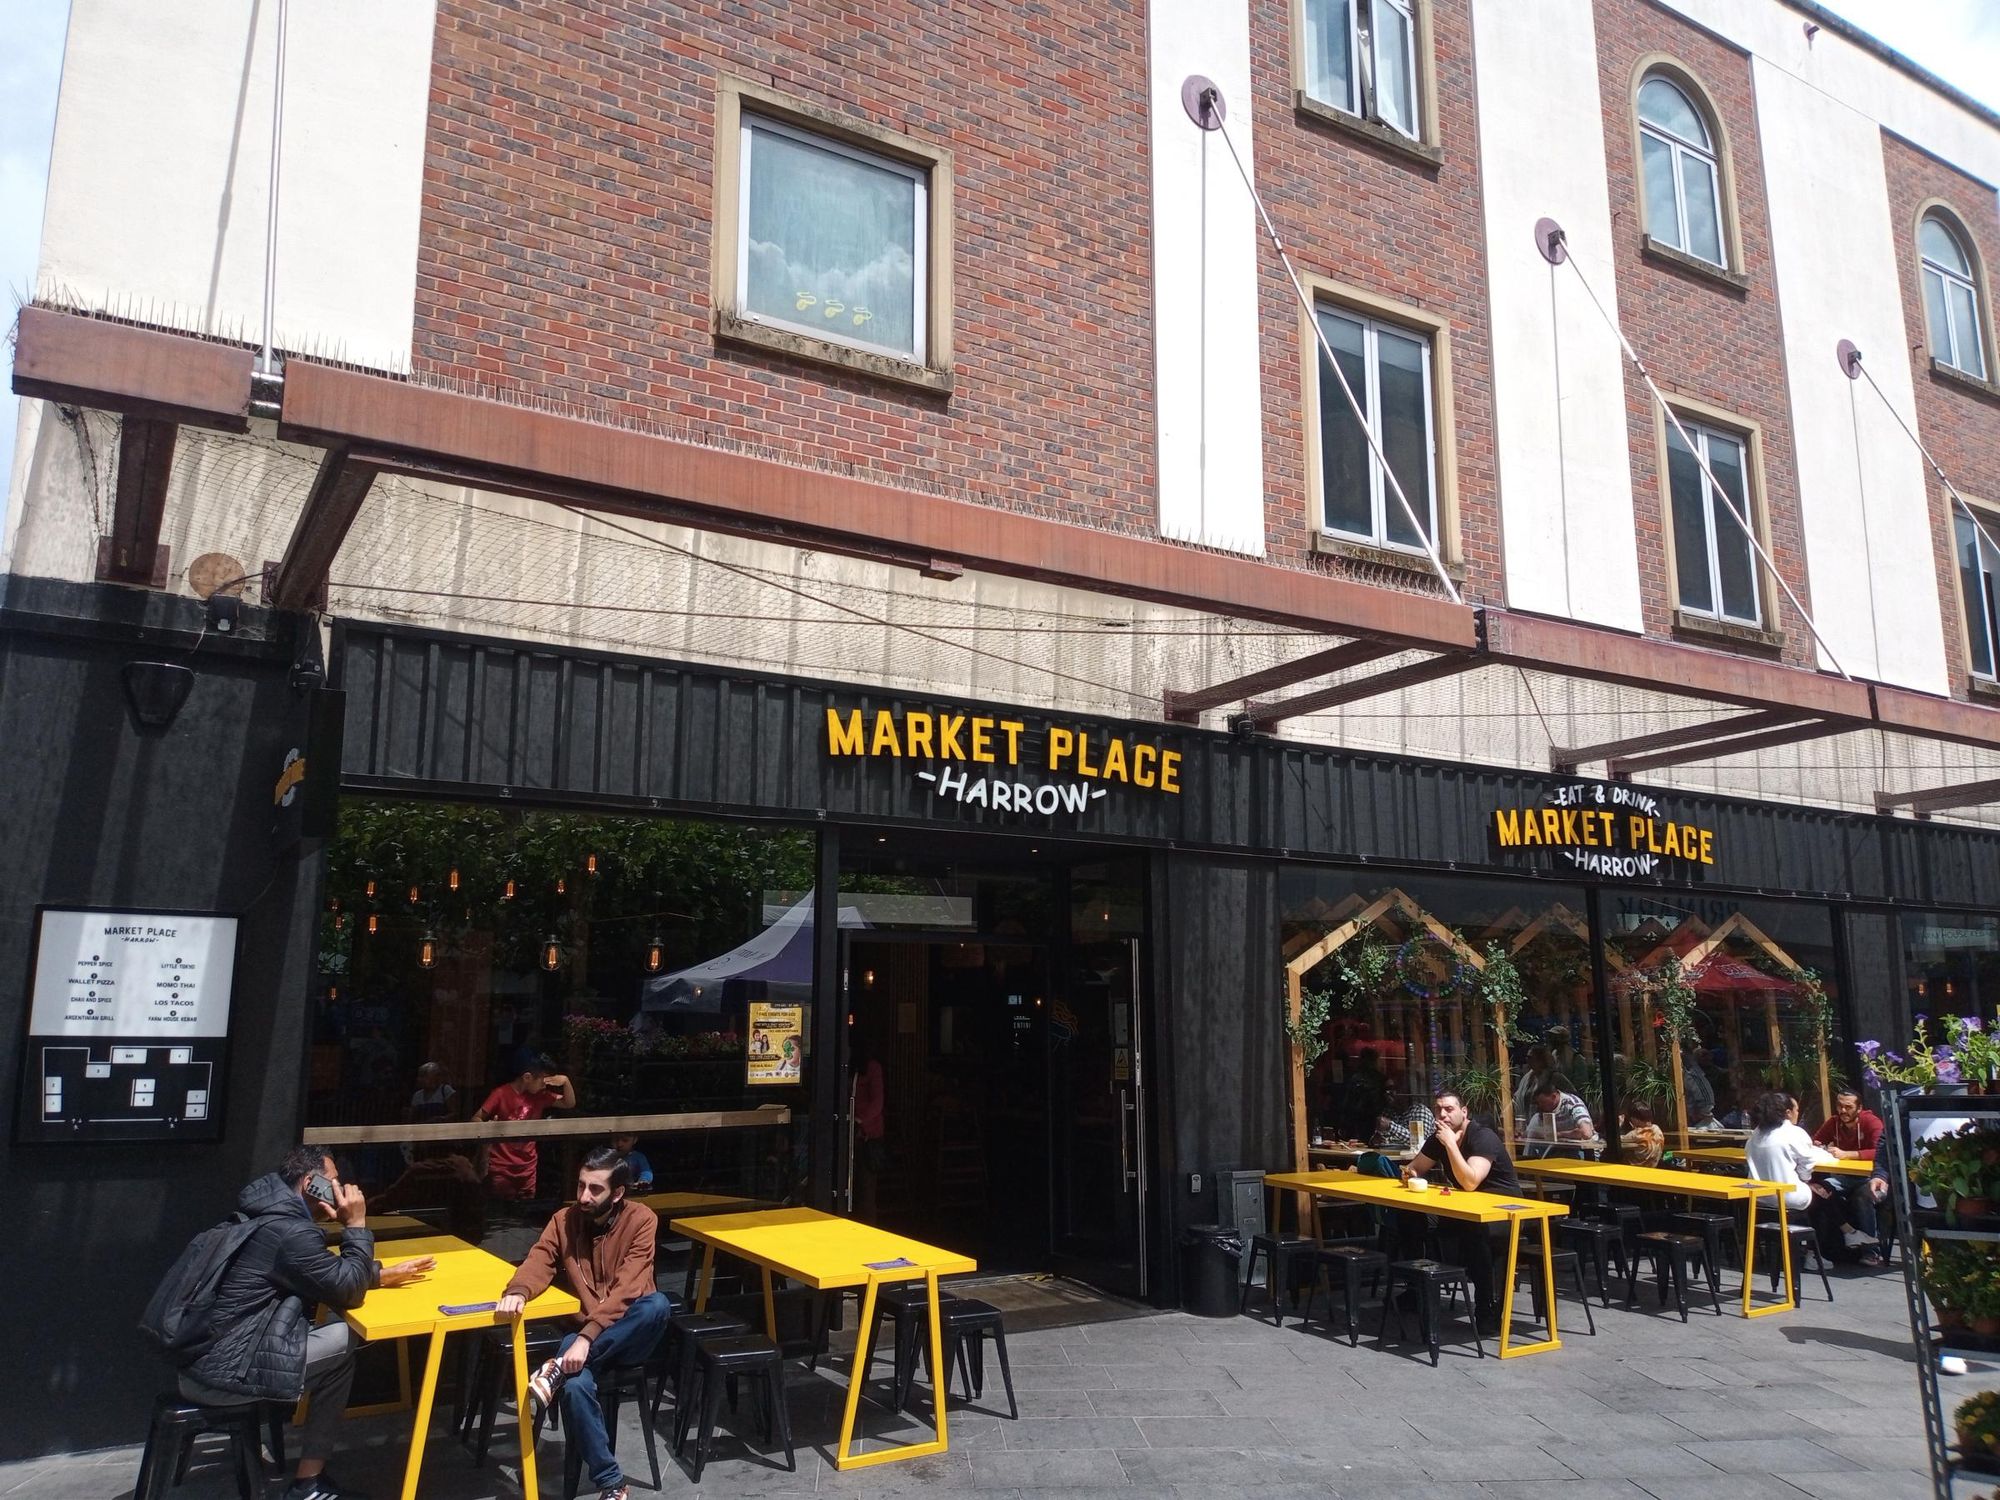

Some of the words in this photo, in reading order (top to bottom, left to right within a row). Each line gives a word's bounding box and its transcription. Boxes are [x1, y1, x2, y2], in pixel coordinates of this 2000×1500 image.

[826, 708, 1024, 765] MARKET
[1048, 726, 1182, 794] PLACE
[1595, 784, 1606, 804] &
[1496, 808, 1615, 847] MARKET
[1629, 815, 1714, 865] PLACE
[104, 927, 143, 935] MARKET
[147, 927, 177, 938] PLACE
